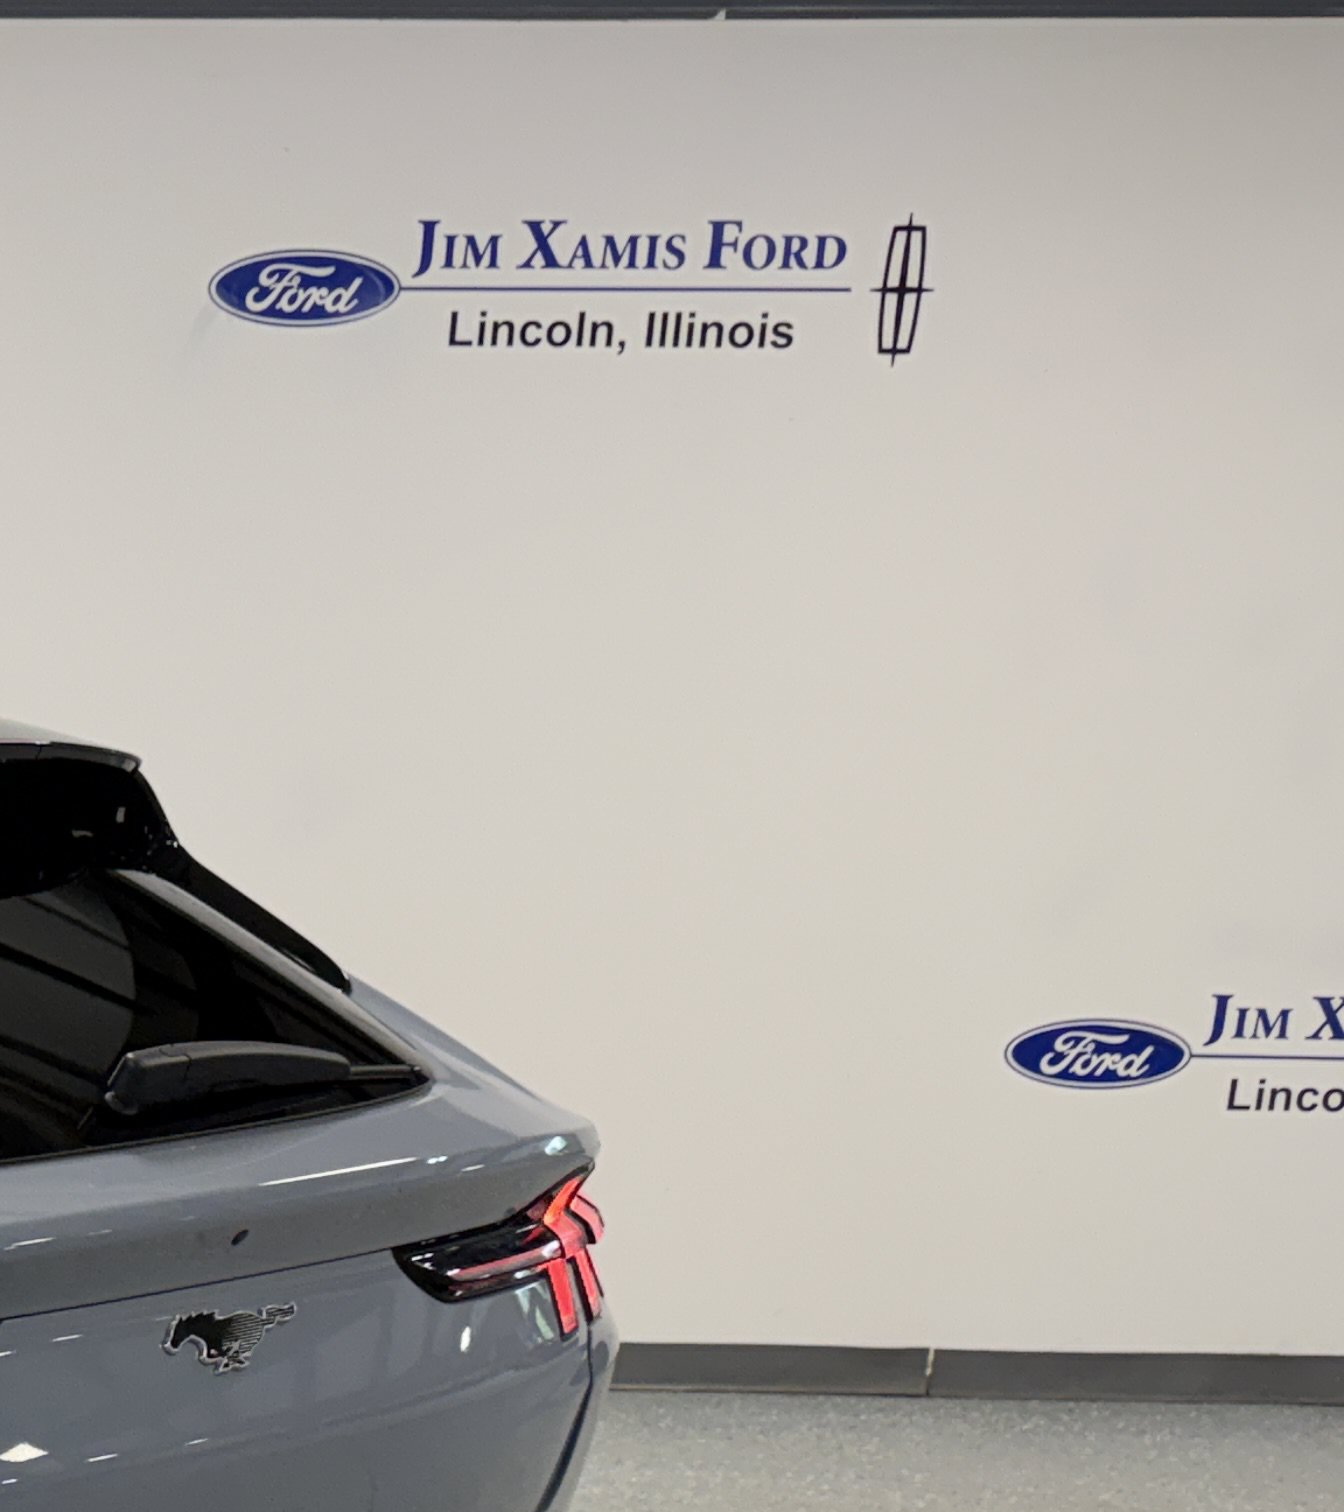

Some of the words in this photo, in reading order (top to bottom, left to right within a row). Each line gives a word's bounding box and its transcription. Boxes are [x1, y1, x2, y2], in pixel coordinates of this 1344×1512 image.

[412, 219, 503, 278] JIM
[515, 219, 686, 271] XAMIS
[703, 219, 848, 271] FORD
[244, 260, 359, 315] Ford
[447, 311, 627, 356] Lincoln,
[644, 312, 794, 349] Illinois
[1203, 994, 1294, 1047] JIM
[1039, 1030, 1155, 1078] Ford
